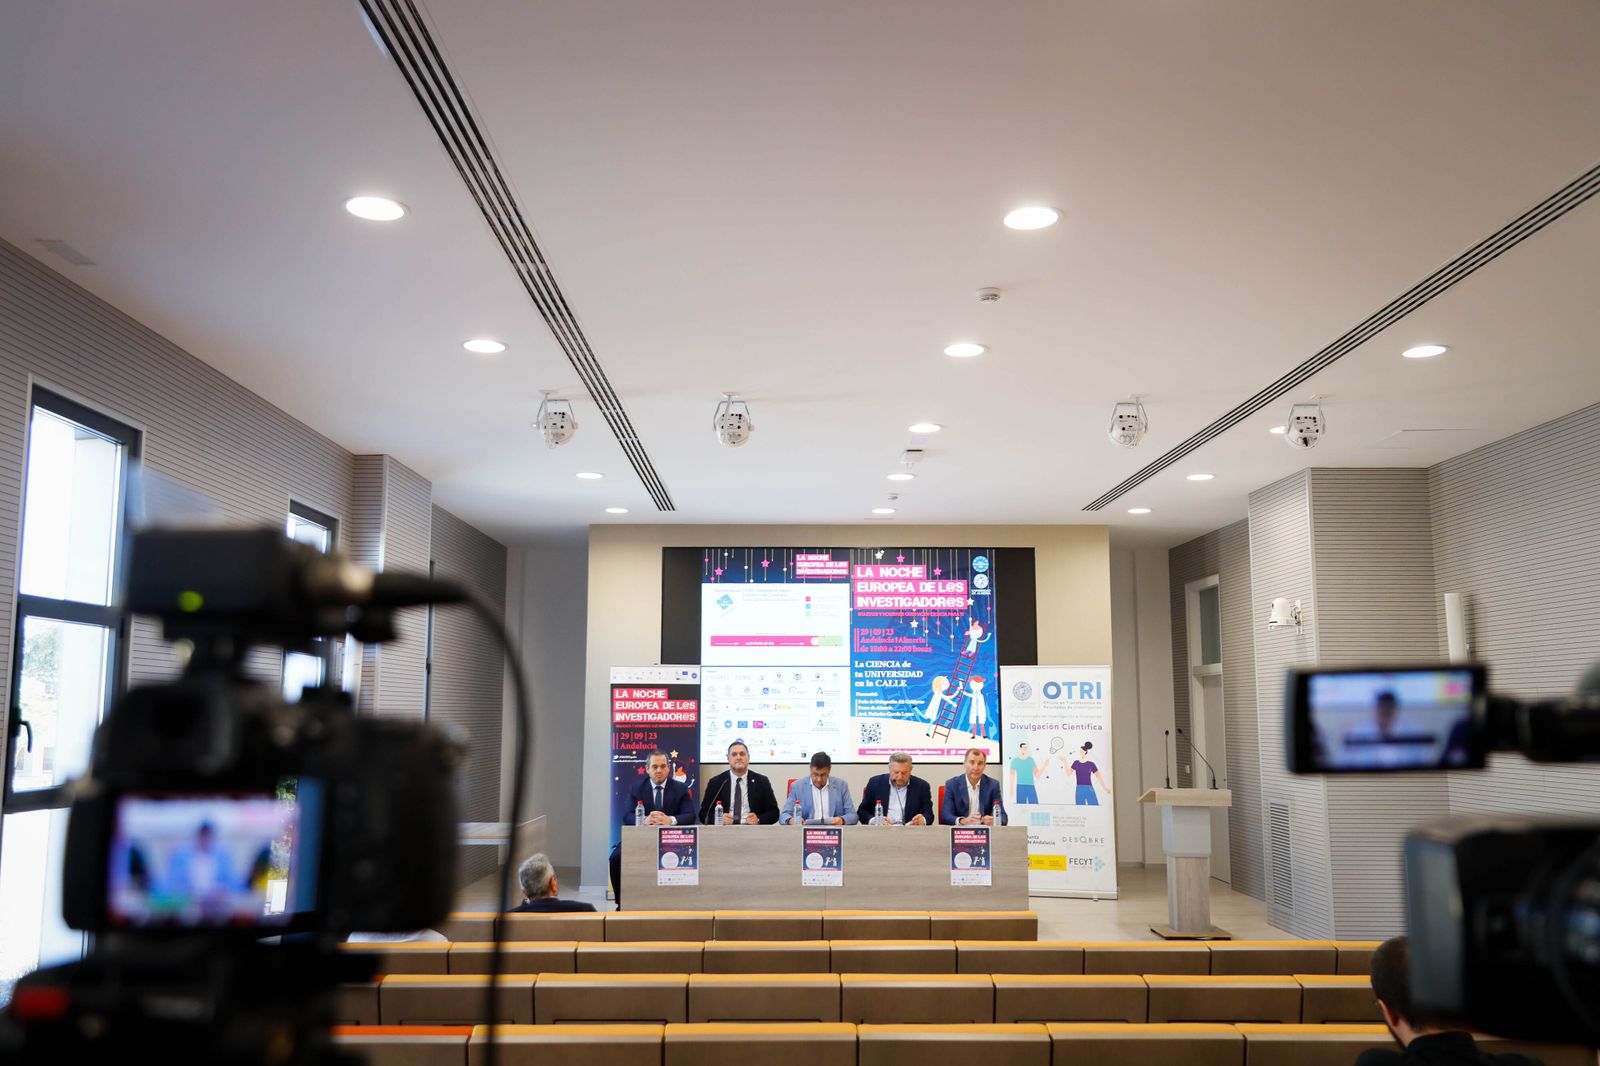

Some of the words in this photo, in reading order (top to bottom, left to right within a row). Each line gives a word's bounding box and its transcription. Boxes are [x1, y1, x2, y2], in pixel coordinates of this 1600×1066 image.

[857, 566, 874, 578] LA
[880, 566, 923, 578] NOCHE
[857, 582, 915, 592] EUROPEA
[920, 582, 936, 592] DE
[938, 582, 964, 592] L@S
[857, 596, 964, 608] INVESTIGADOR@S
[616, 690, 628, 698] LA
[633, 690, 665, 698] NOCHE
[1043, 682, 1102, 699] OTRI
[1010, 723, 1059, 731] Divulgación
